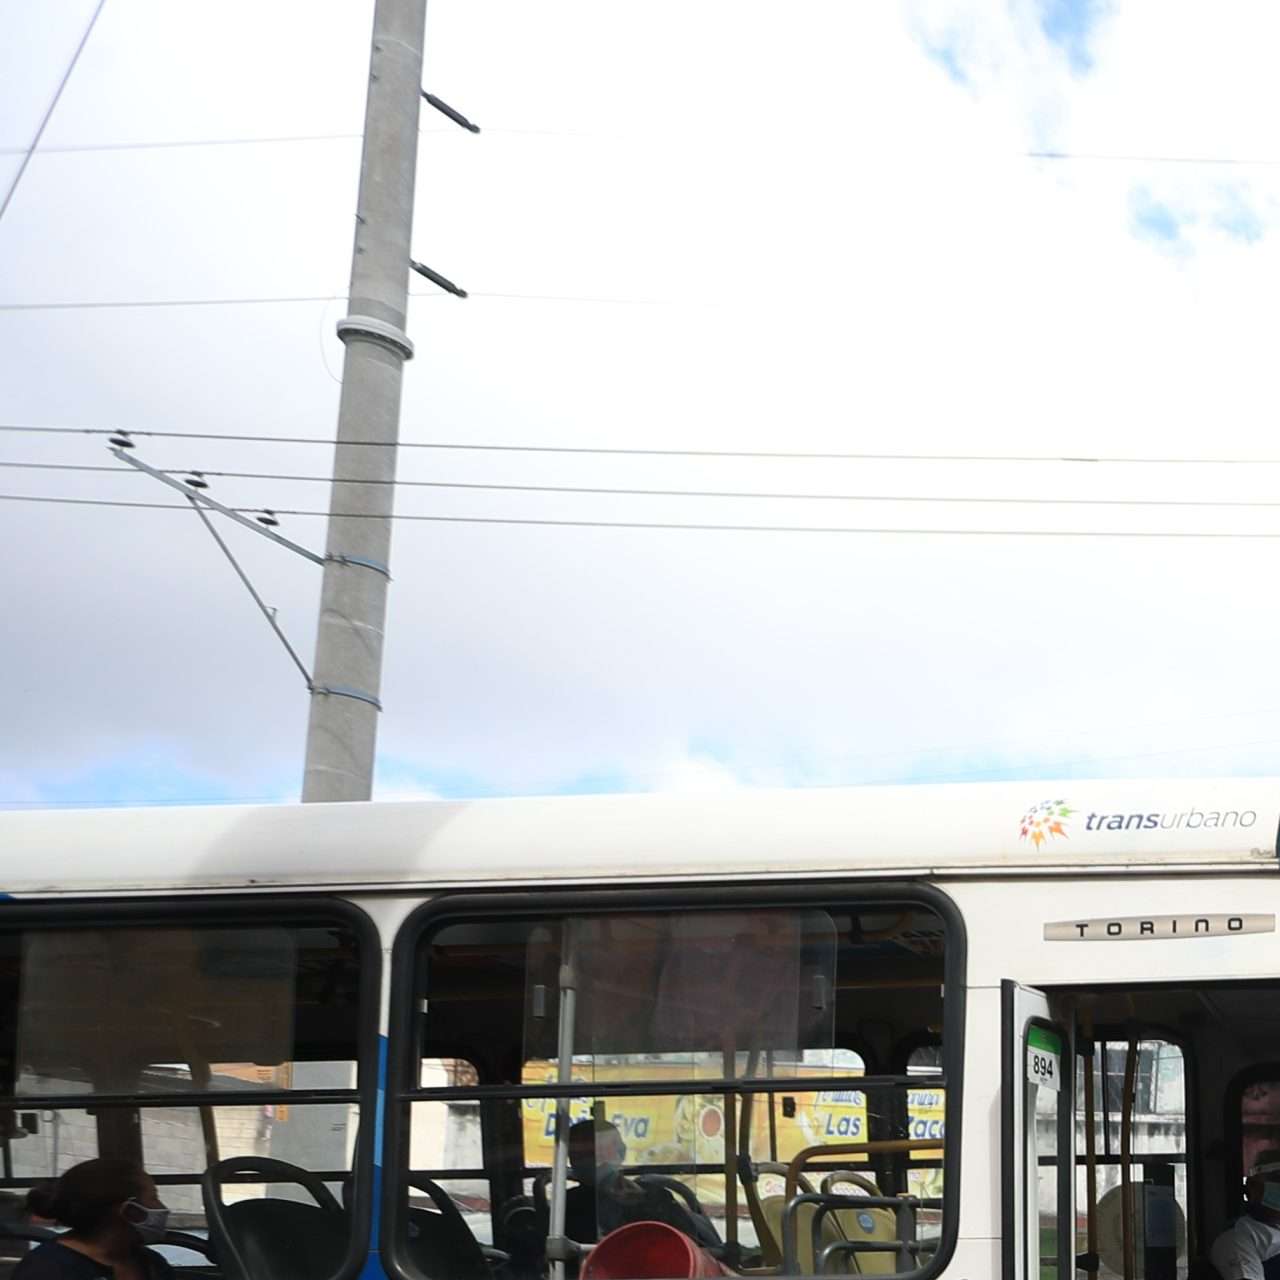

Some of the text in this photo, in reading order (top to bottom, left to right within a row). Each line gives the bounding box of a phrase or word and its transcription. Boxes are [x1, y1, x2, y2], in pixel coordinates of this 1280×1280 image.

[1085, 807, 1257, 831] transurbano
[1075, 917, 1244, 937] TORINO
[1033, 1055, 1053, 1079] 894
[825, 1112, 861, 1137] Las
